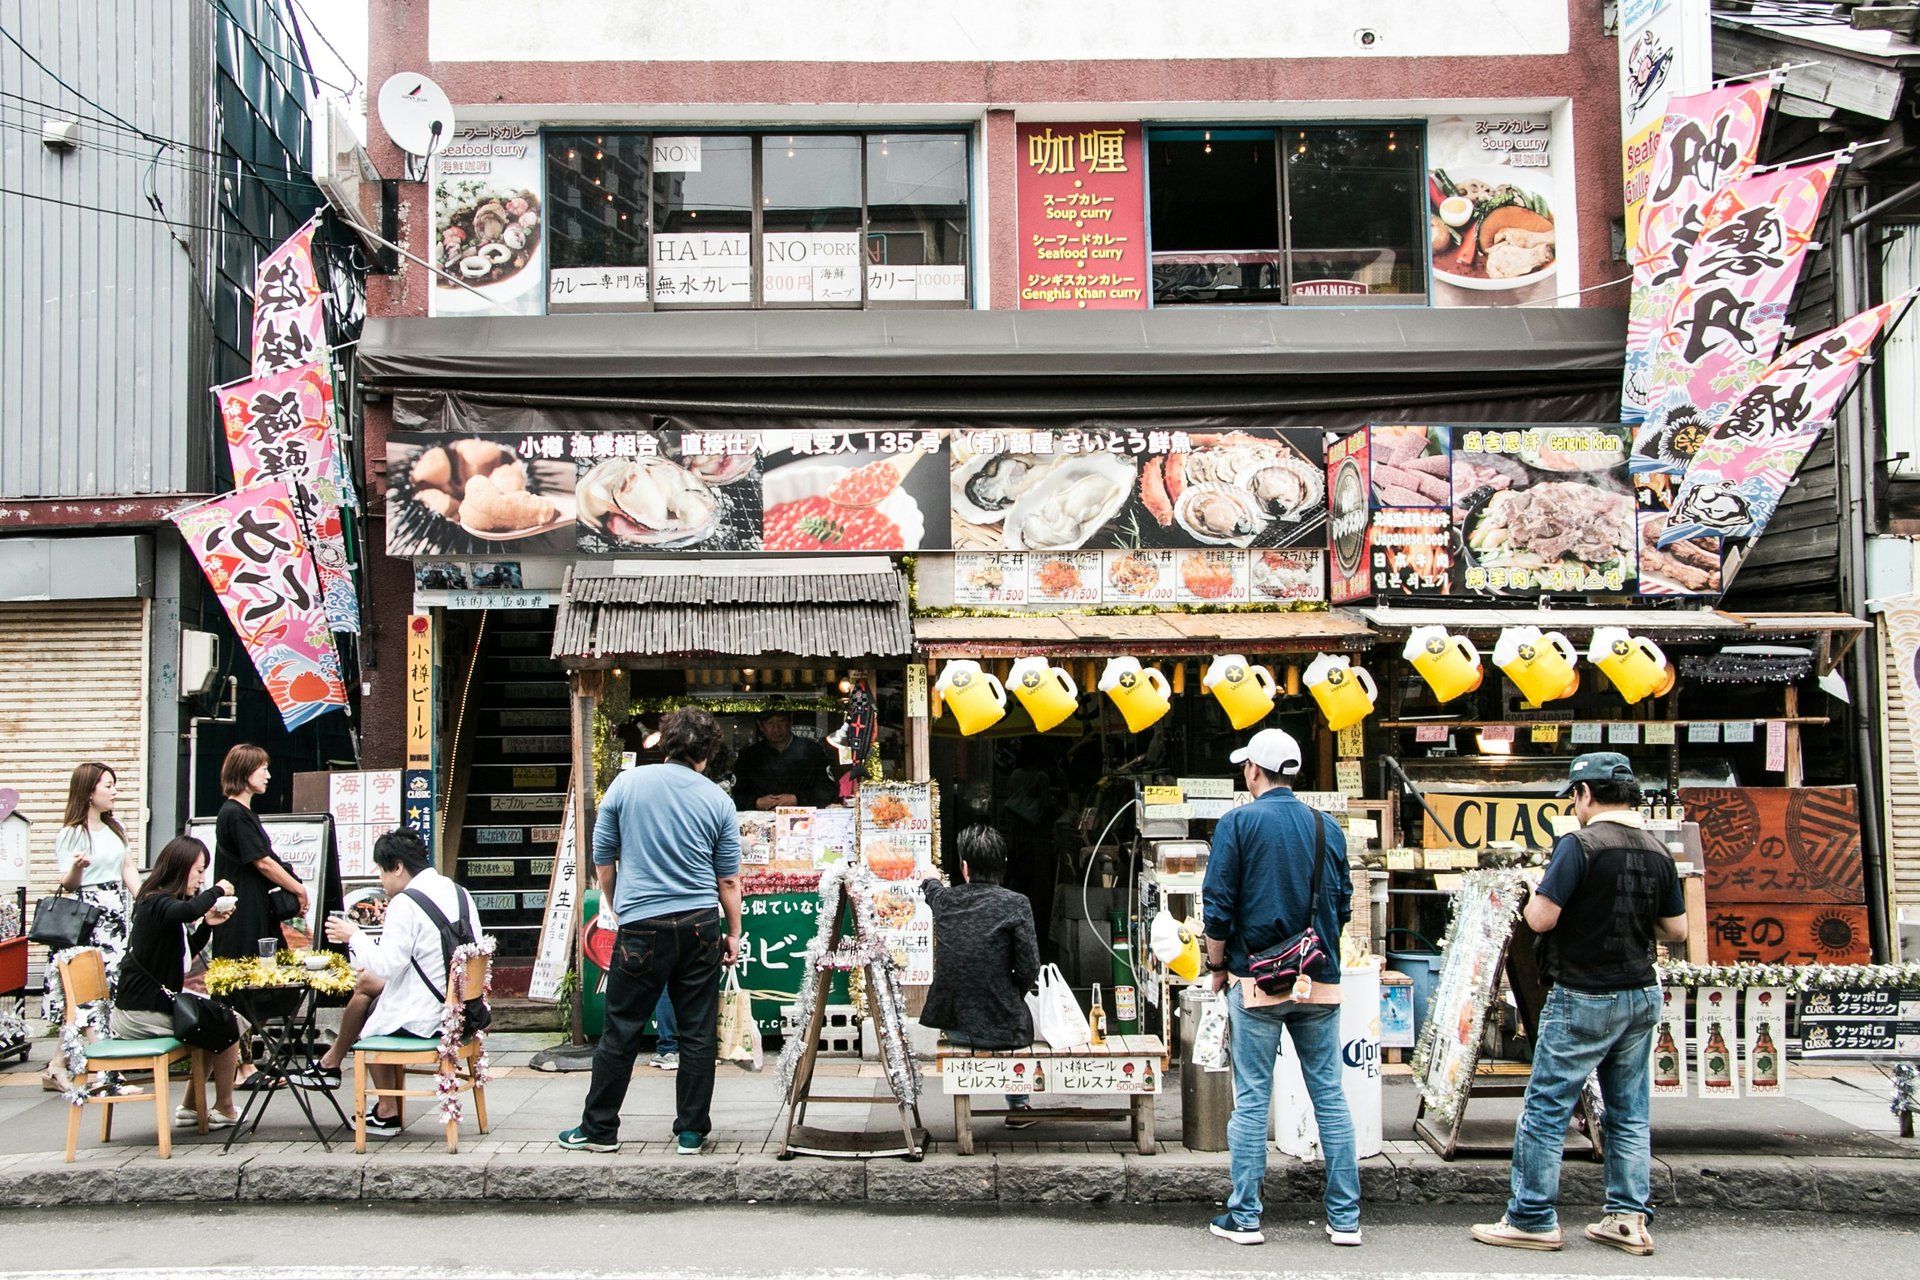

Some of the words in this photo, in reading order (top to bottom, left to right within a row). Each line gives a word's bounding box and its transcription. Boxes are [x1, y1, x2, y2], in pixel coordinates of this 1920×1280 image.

[453, 126, 538, 140] ーフードカレー
[1474, 119, 1548, 134] スープカレー
[493, 145, 526, 158] curry
[1028, 128, 1128, 175] 咖喱
[1481, 136, 1513, 152] Soup
[1514, 138, 1548, 153] curry
[654, 145, 699, 163] NON
[1043, 193, 1115, 206] スープカレー
[1046, 207, 1078, 222] Soup
[1079, 209, 1113, 222] curry
[1032, 234, 1128, 247] シーフードカレー
[656, 239, 748, 262] HALAL
[767, 240, 807, 262] NO
[812, 242, 856, 256] PORK
[1037, 247, 1088, 260] Seafood
[1090, 248, 1123, 261] curry
[820, 267, 846, 280] 海鮮
[868, 271, 915, 290] カリー
[1027, 273, 1136, 287] ジンギスカンカレー
[551, 273, 646, 294] カレー専門店
[655, 274, 749, 296] 無水カレー
[821, 287, 855, 298] スープ
[1021, 288, 1072, 303] Genghis
[1074, 287, 1106, 299] Khan
[1109, 289, 1142, 301] curry
[518, 434, 564, 458] 小樽
[570, 433, 659, 458] 漁業組合
[679, 433, 773, 457] 直接仕入
[1062, 431, 1192, 455] さいとう鮮魚
[1462, 431, 1542, 453] 成吉思汗
[1549, 433, 1591, 453] Genghis
[1591, 432, 1620, 452] Khan
[1373, 532, 1423, 548] Japanese
[1424, 530, 1451, 546] beef
[984, 552, 1024, 565] うに丼
[1548, 567, 1624, 591] 징기스칸
[411, 643, 430, 741] 小樽ビール
[335, 774, 361, 823] 海鮮
[406, 790, 432, 799] CLASSIC
[1146, 787, 1179, 797] 生ビール
[281, 851, 316, 864] curry
[1709, 913, 1786, 948] 俺の
[1837, 990, 1889, 1003] サッポロ
[1804, 1004, 1836, 1014] CLASSIC
[1836, 1003, 1898, 1015] クラシック
[1834, 1023, 1886, 1036] サッポロ
[1804, 1038, 1833, 1049] CLASSIC
[1834, 1036, 1895, 1048] クラシック
[946, 1059, 1008, 1075] 小樽ビール
[1055, 1059, 1118, 1075] 小樽ビール
[957, 1074, 1024, 1090] ピルスナー
[1004, 1083, 1032, 1093] 500円
[1063, 1074, 1131, 1090] ピルスナー
[1115, 1082, 1144, 1093] 500円
